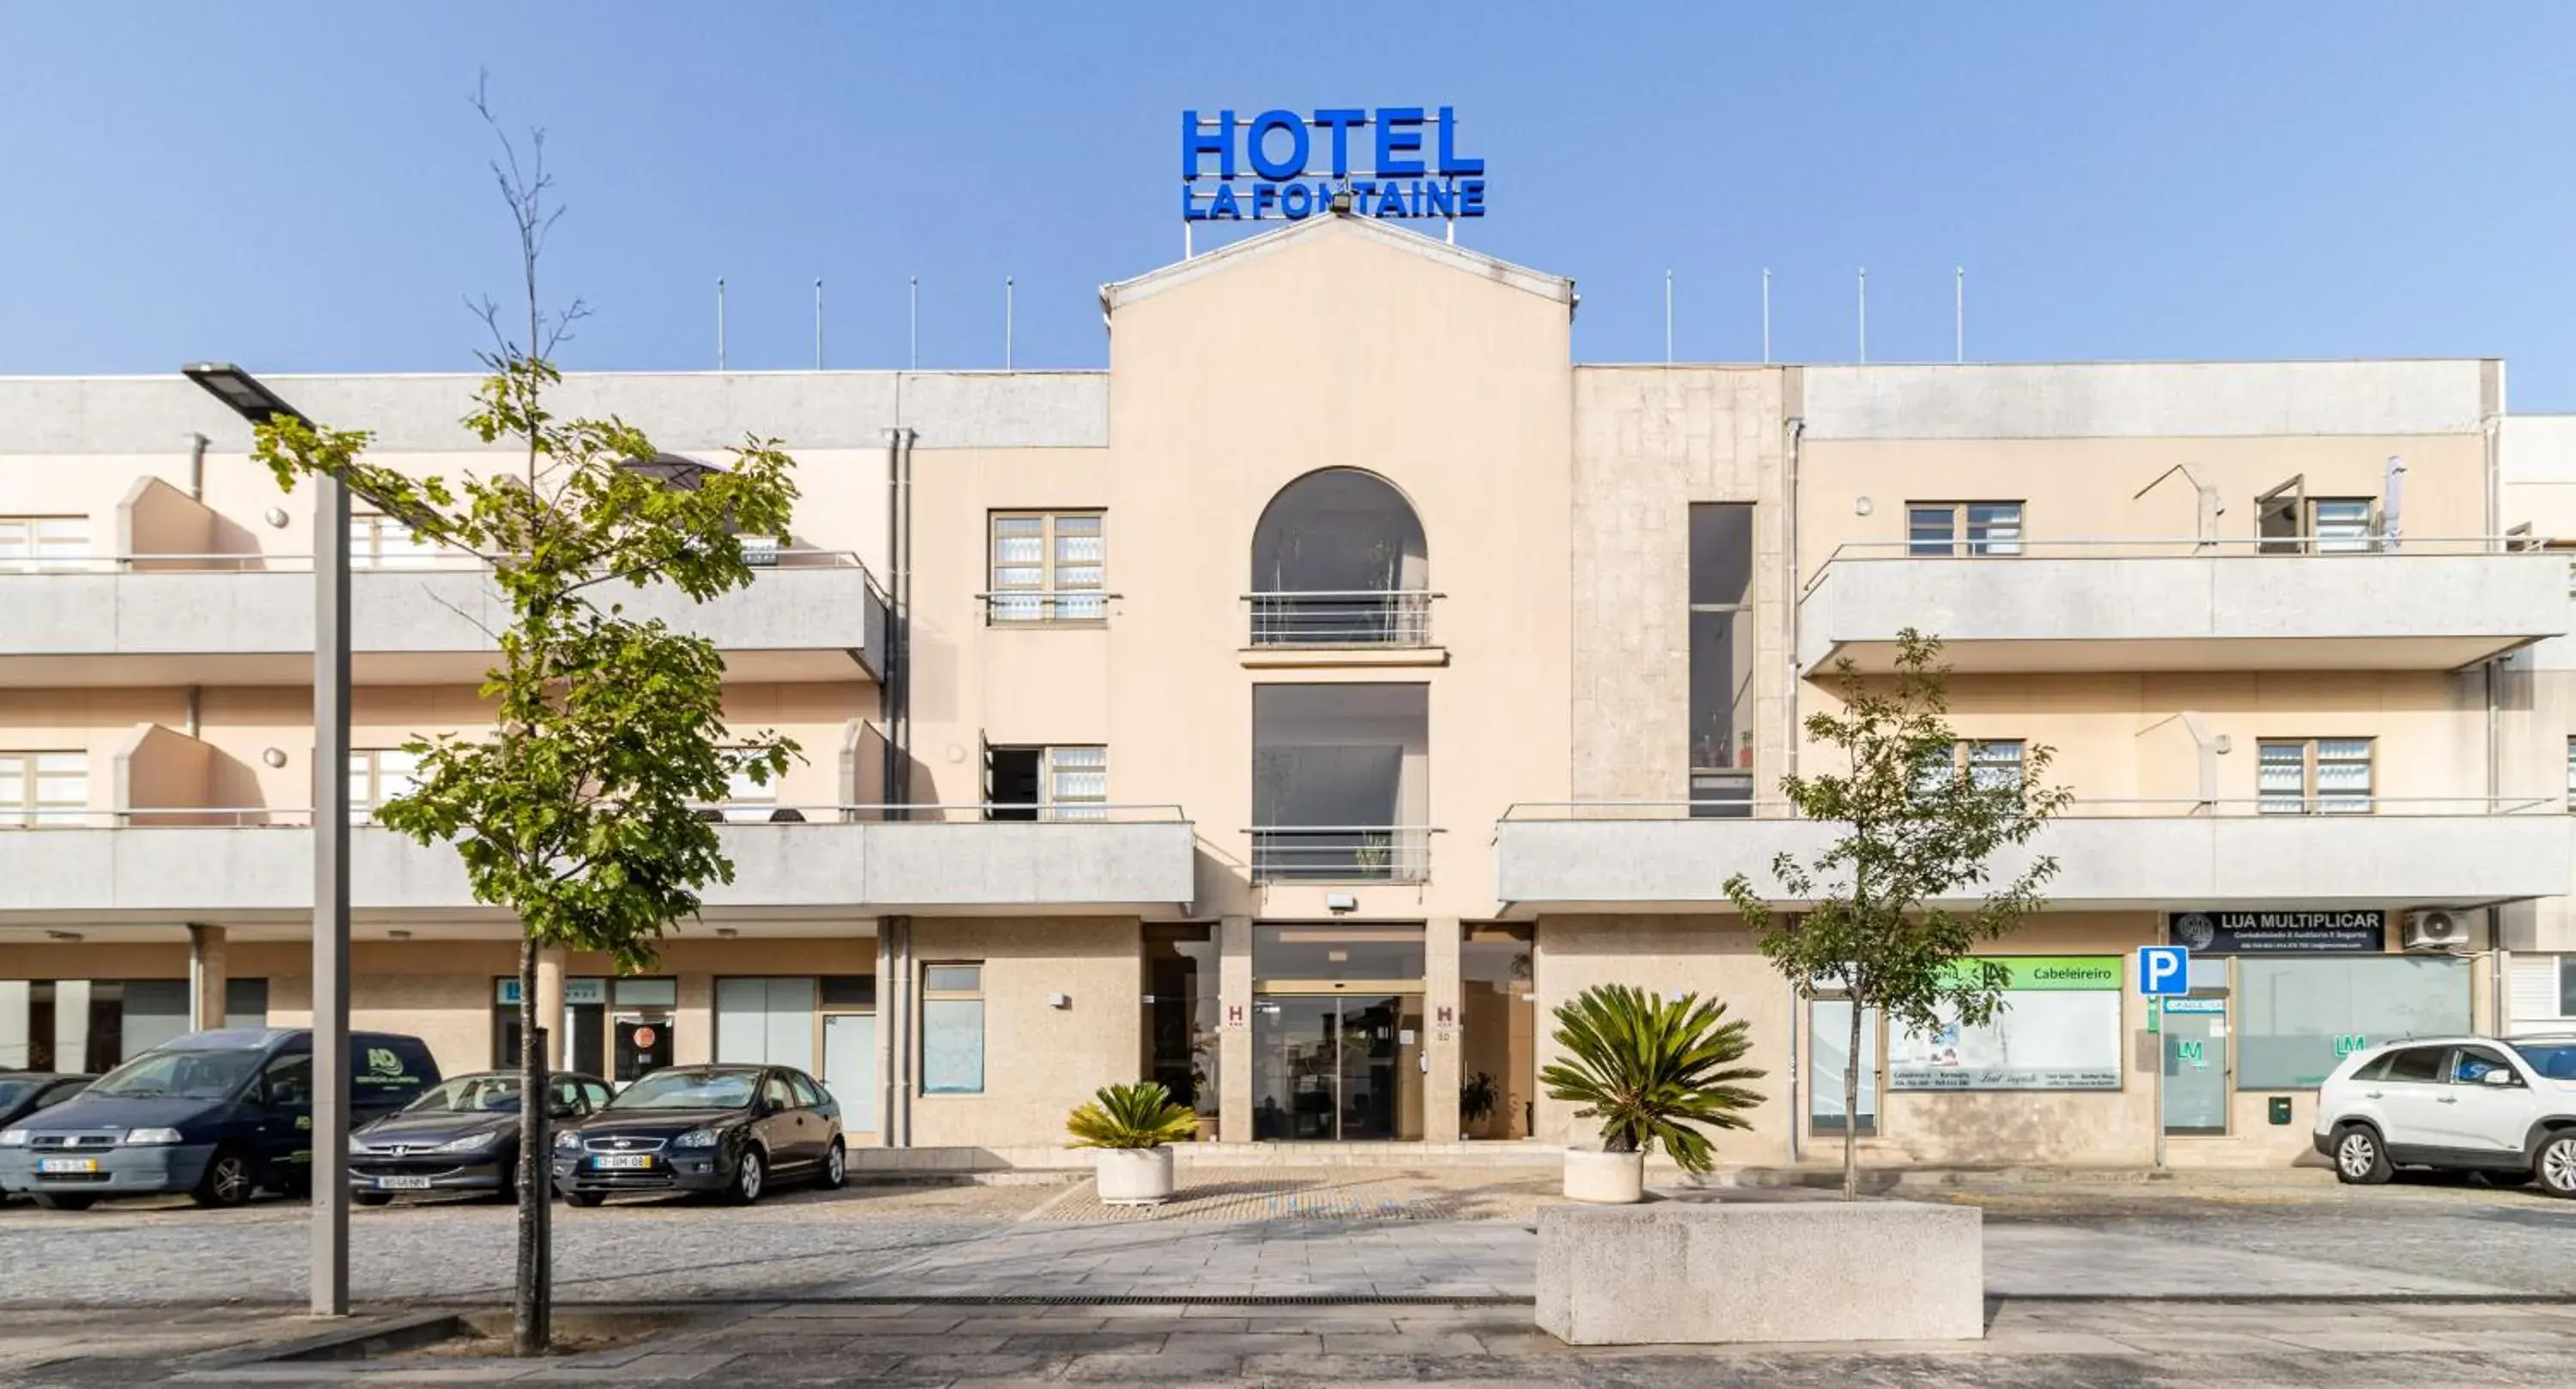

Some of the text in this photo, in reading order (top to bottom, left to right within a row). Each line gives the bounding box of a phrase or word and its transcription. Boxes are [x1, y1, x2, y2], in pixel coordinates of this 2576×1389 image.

[1182, 106, 1485, 182] HOTEL
[1183, 184, 1241, 220] LA
[2221, 913, 2379, 928] LUA MULTIPLICAR
[2033, 967, 2111, 980] Cabeleireiro
[2149, 950, 2178, 991] P
[1230, 1005, 1242, 1021] H
[1437, 1007, 1452, 1022] H
